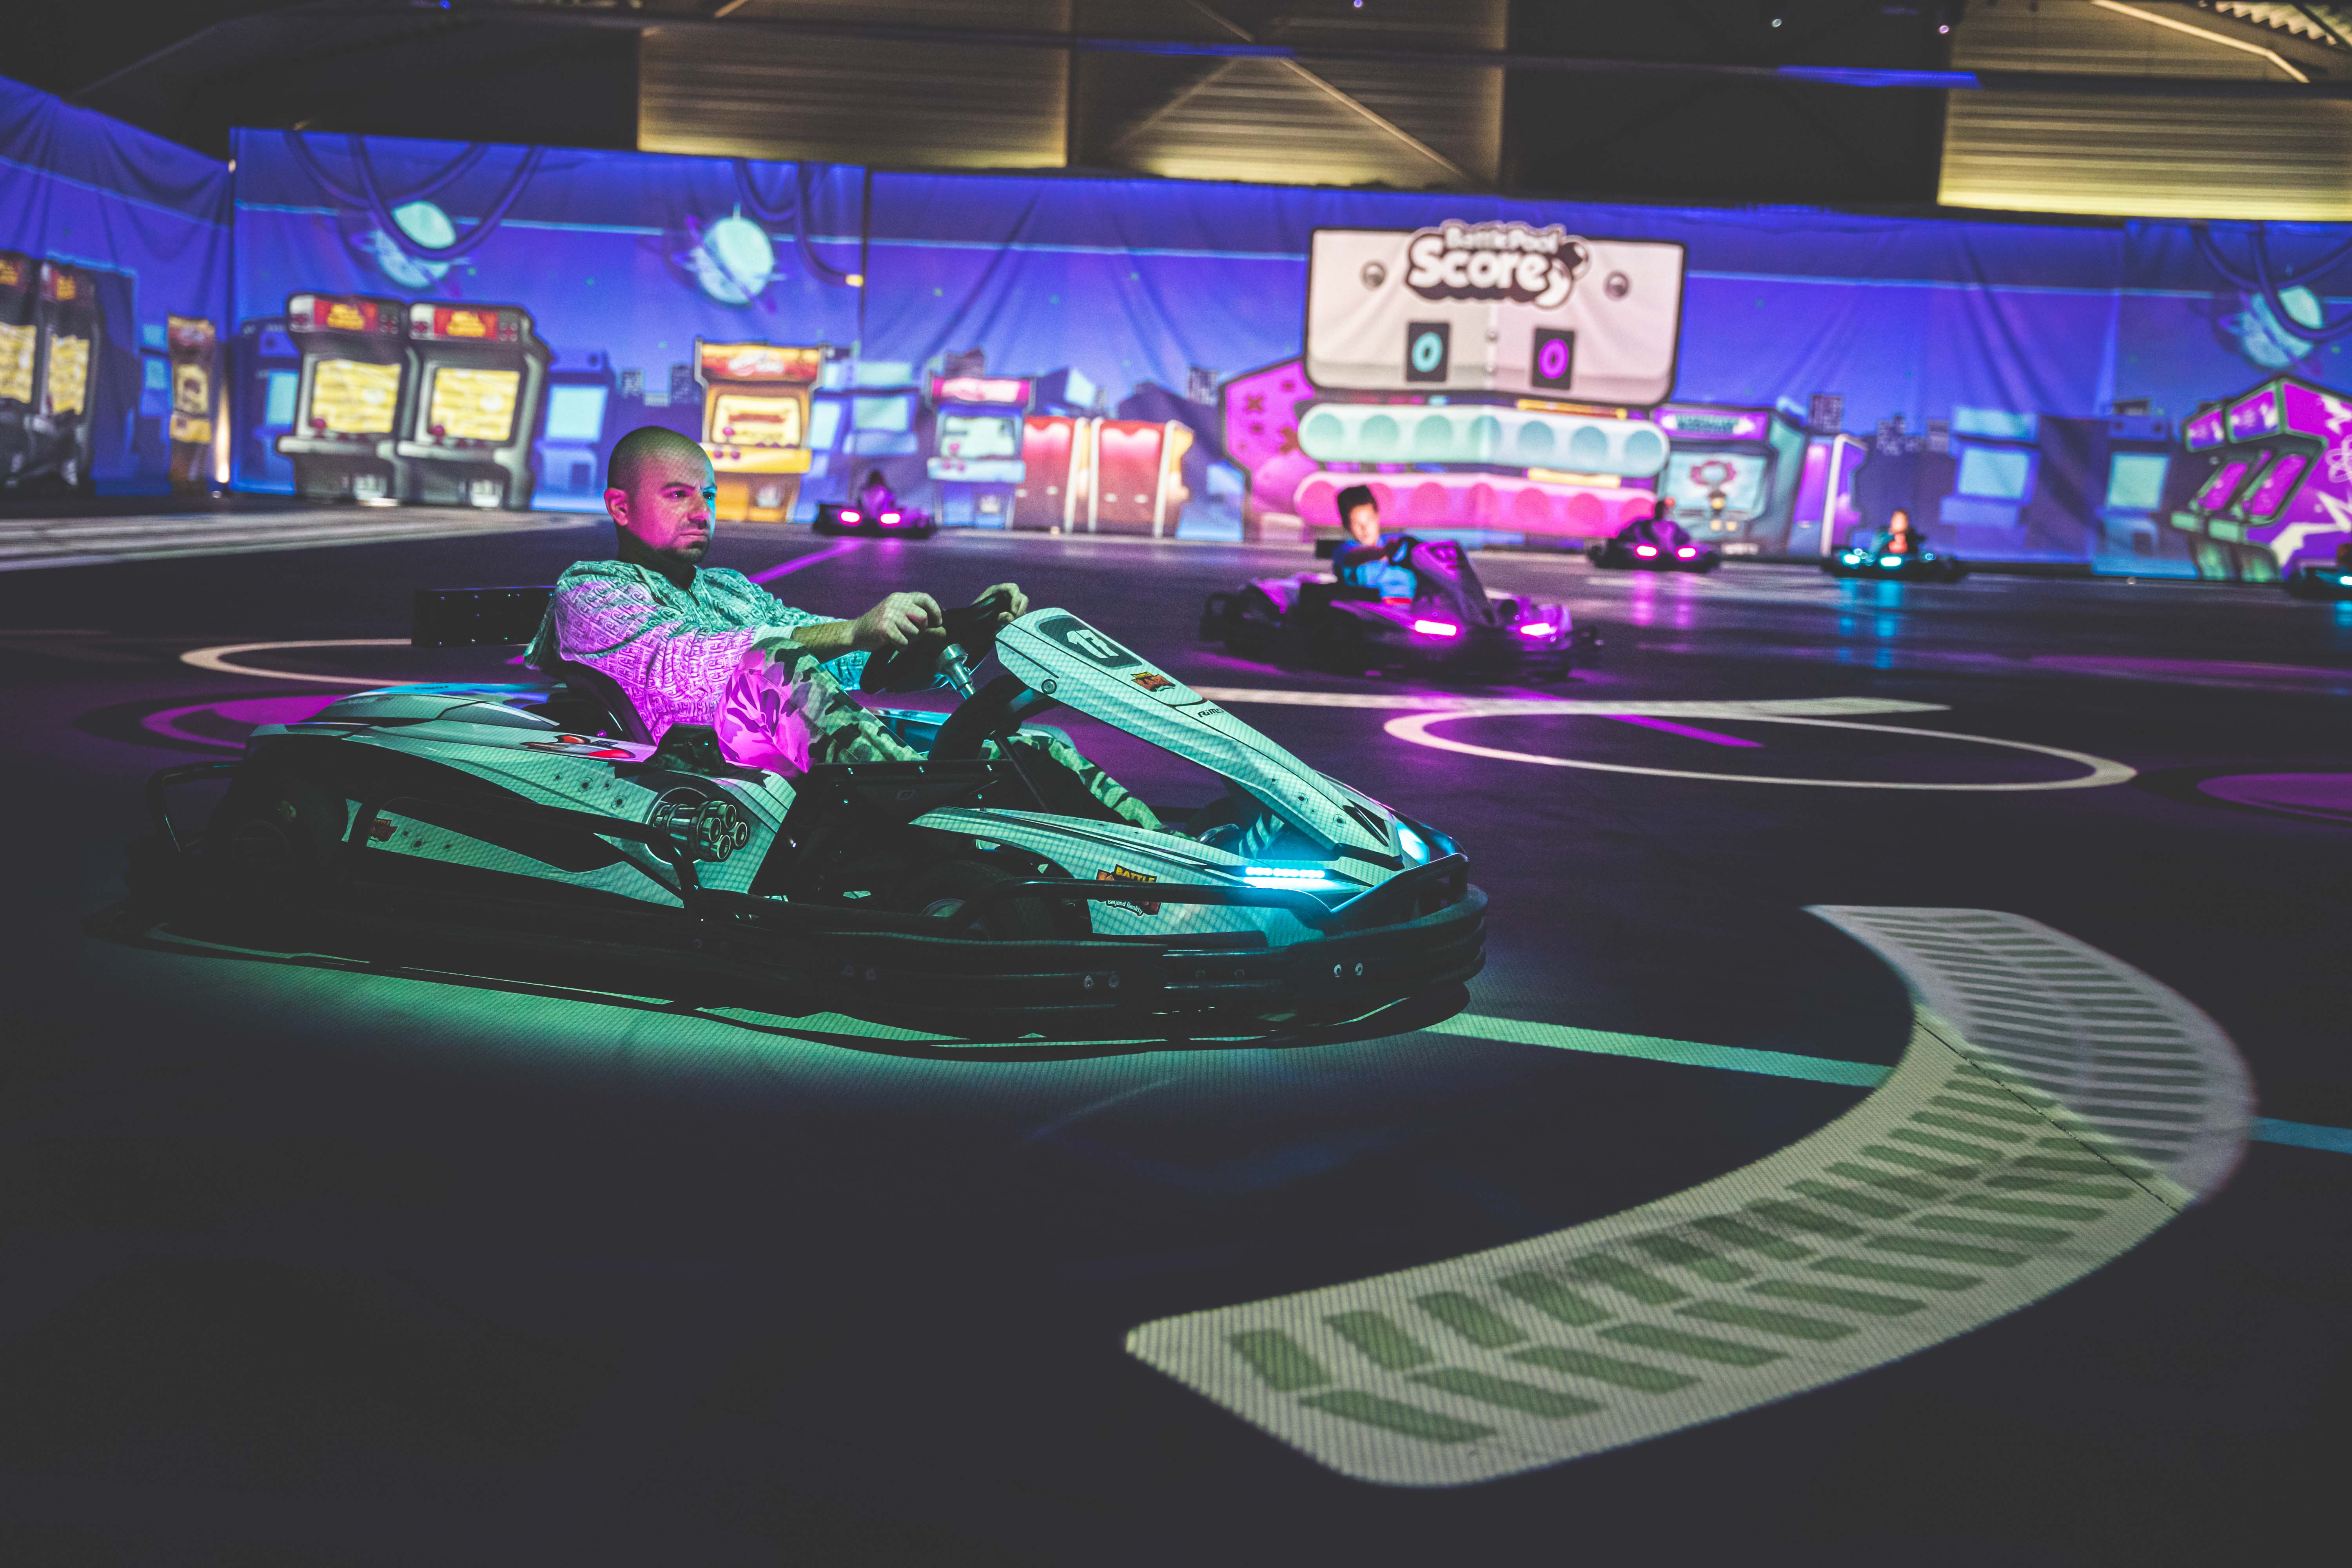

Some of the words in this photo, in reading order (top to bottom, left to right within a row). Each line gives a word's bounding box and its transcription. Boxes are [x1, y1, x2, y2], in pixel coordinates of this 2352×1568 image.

[1408, 236, 1549, 292] Score
[1412, 332, 1443, 372] 0
[1539, 339, 1568, 379] 0
[1116, 867, 1155, 882] BATTLE
[1126, 902, 1143, 915] Reality
